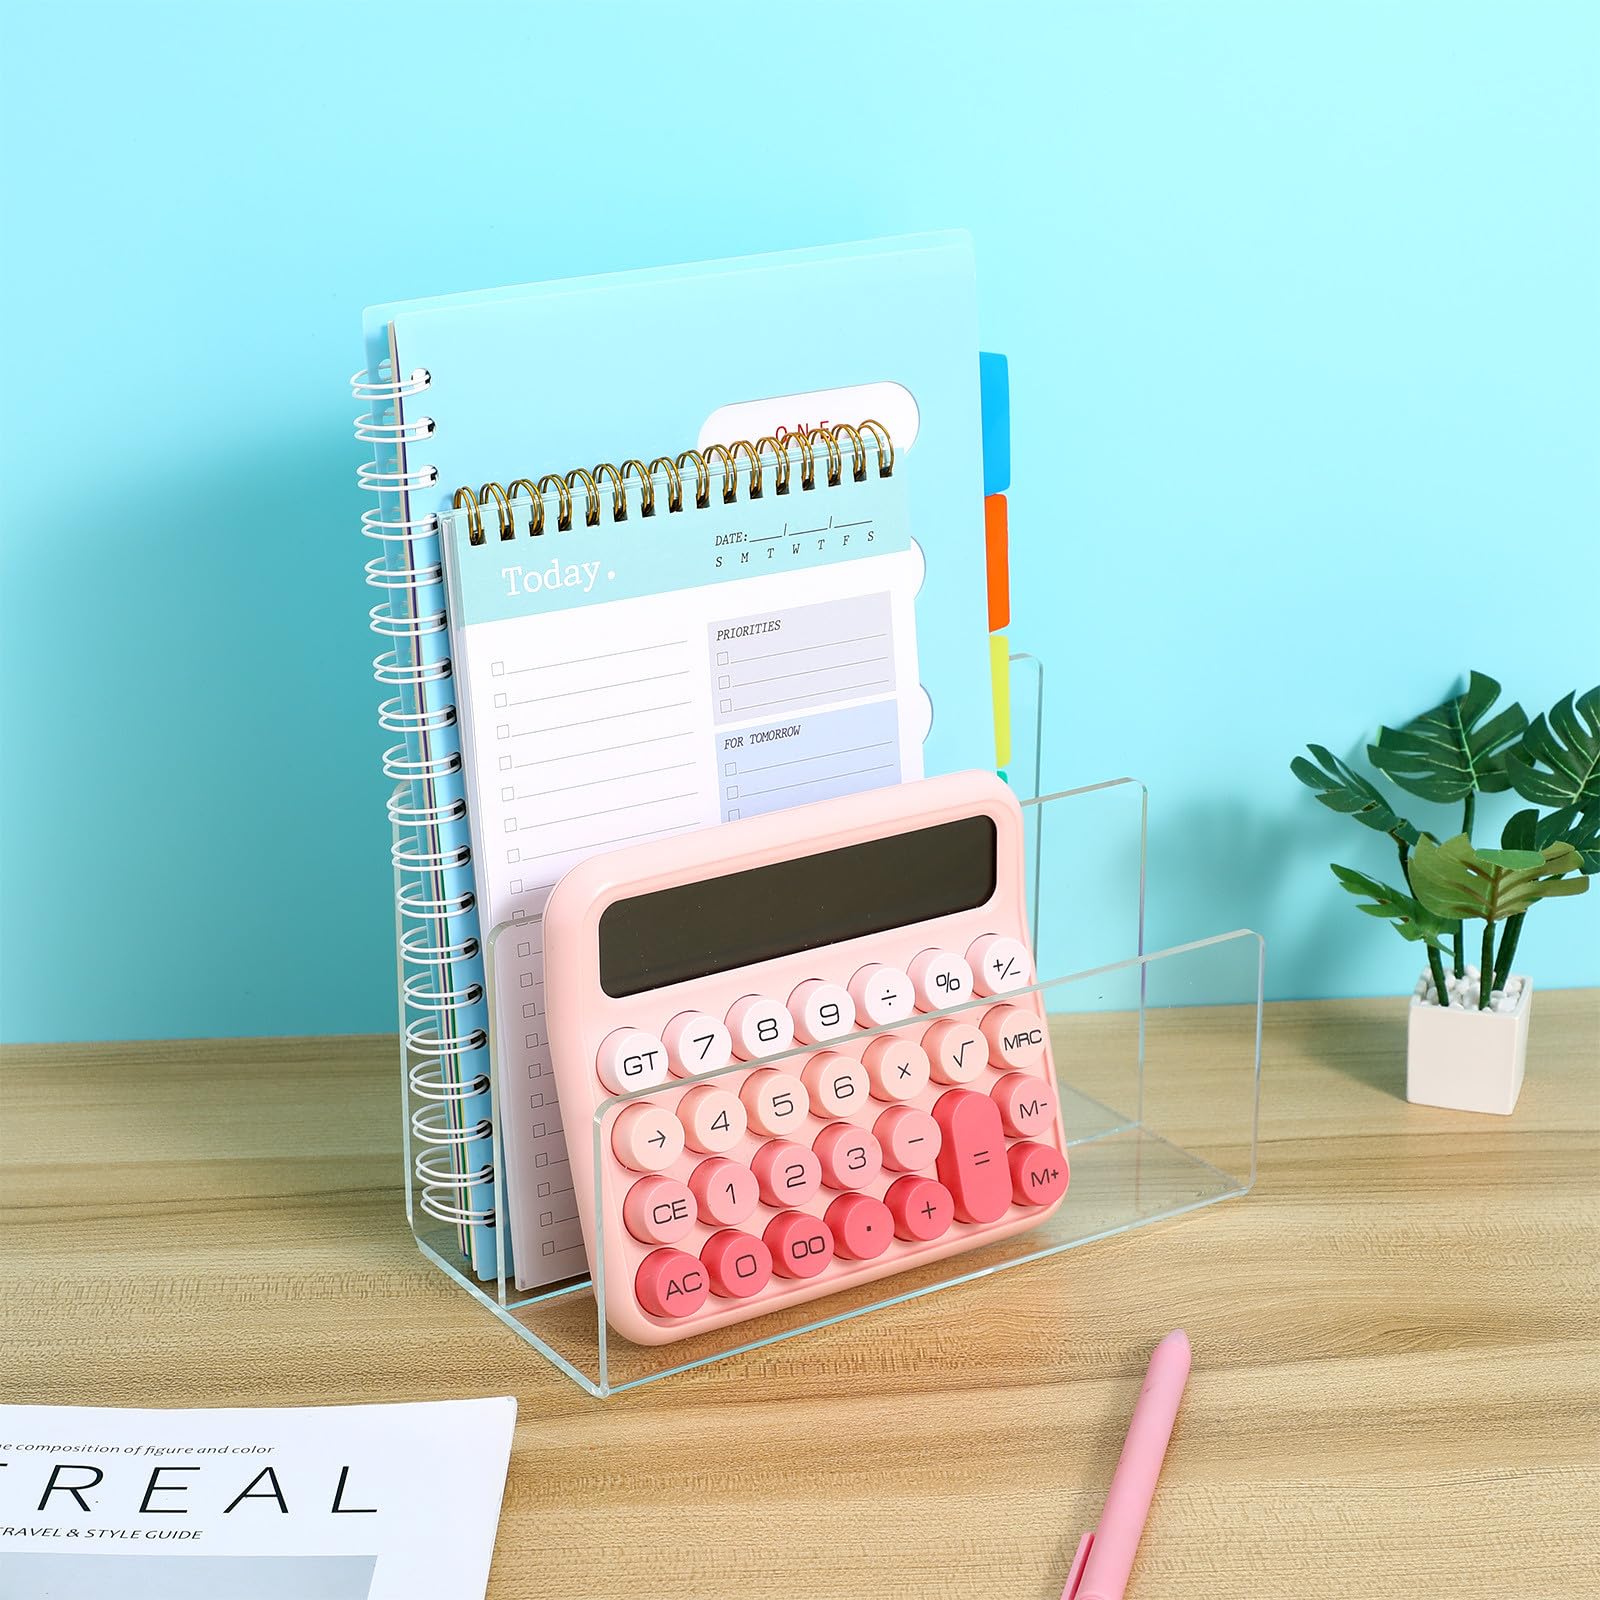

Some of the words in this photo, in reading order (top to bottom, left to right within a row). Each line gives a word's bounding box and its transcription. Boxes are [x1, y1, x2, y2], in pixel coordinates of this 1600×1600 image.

[715, 556, 723, 568] S
[740, 552, 749, 563] M
[766, 548, 775, 559] T
[792, 543, 801, 555] W
[817, 539, 826, 550] T
[842, 535, 851, 546] F
[867, 531, 875, 542] S
[501, 558, 616, 597] Today.
[716, 619, 782, 641] PRIORITIES
[723, 736, 744, 750] FOR
[749, 725, 802, 745] TOMORROW
[623, 1051, 659, 1076] GT
[693, 1034, 715, 1060] 7
[757, 1018, 779, 1042] 8
[819, 1003, 840, 1027] 9
[935, 972, 961, 993] %
[710, 1110, 730, 1132] 4
[772, 1092, 794, 1117] 5
[833, 1075, 855, 1099] 6
[1003, 1029, 1043, 1051] MRC
[652, 1199, 688, 1225] CE
[725, 1183, 736, 1204] 1
[785, 1164, 807, 1188] 2
[846, 1147, 867, 1170] 3
[1019, 1100, 1048, 1120] M-
[666, 1271, 703, 1301] AC
[735, 1254, 757, 1278] 0
[1030, 1168, 1059, 1188] M+
[15, 1443, 120, 1455] composition
[123, 1445, 143, 1456] of
[143, 1445, 193, 1456] figure
[196, 1445, 229, 1454] and
[232, 1445, 275, 1454] color
[0, 1463, 378, 1514] REAL
[0, 1527, 62, 1538] RAVEL
[66, 1528, 81, 1538] &
[84, 1528, 142, 1539] STYLE
[145, 1530, 203, 1540] GUIDE
